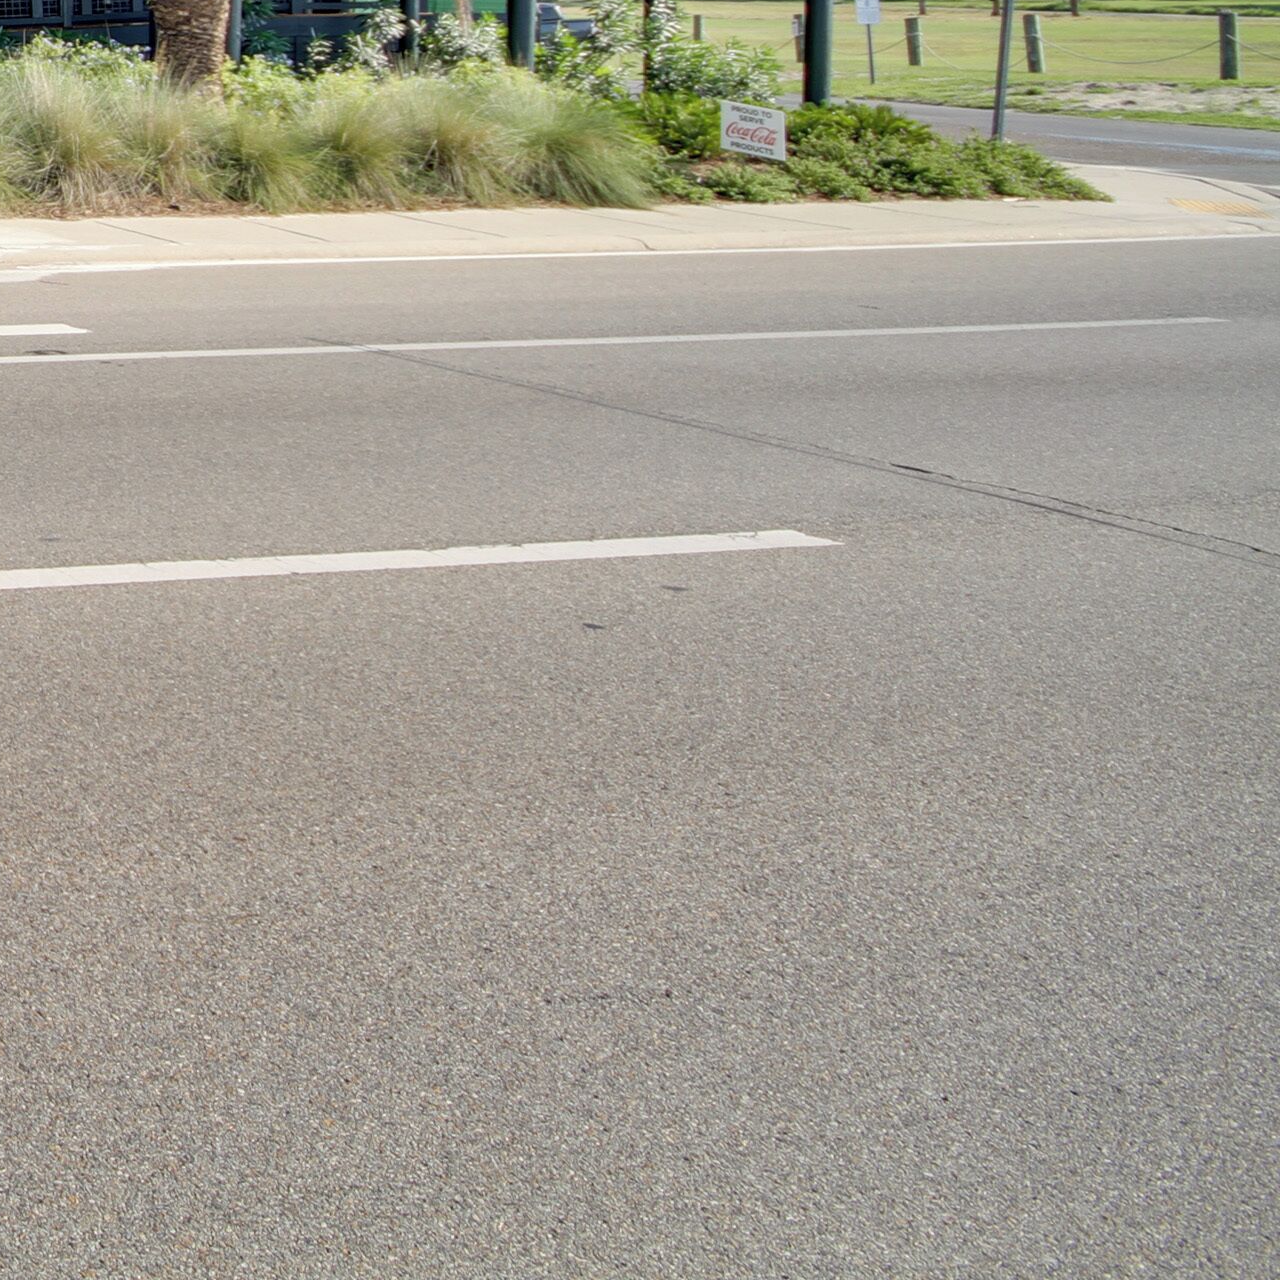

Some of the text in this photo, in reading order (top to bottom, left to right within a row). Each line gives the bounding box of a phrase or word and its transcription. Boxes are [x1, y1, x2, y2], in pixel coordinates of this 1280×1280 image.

[731, 105, 773, 119] PROUD TO
[739, 114, 765, 125] SERVE
[730, 141, 774, 156] PRODUCTS
